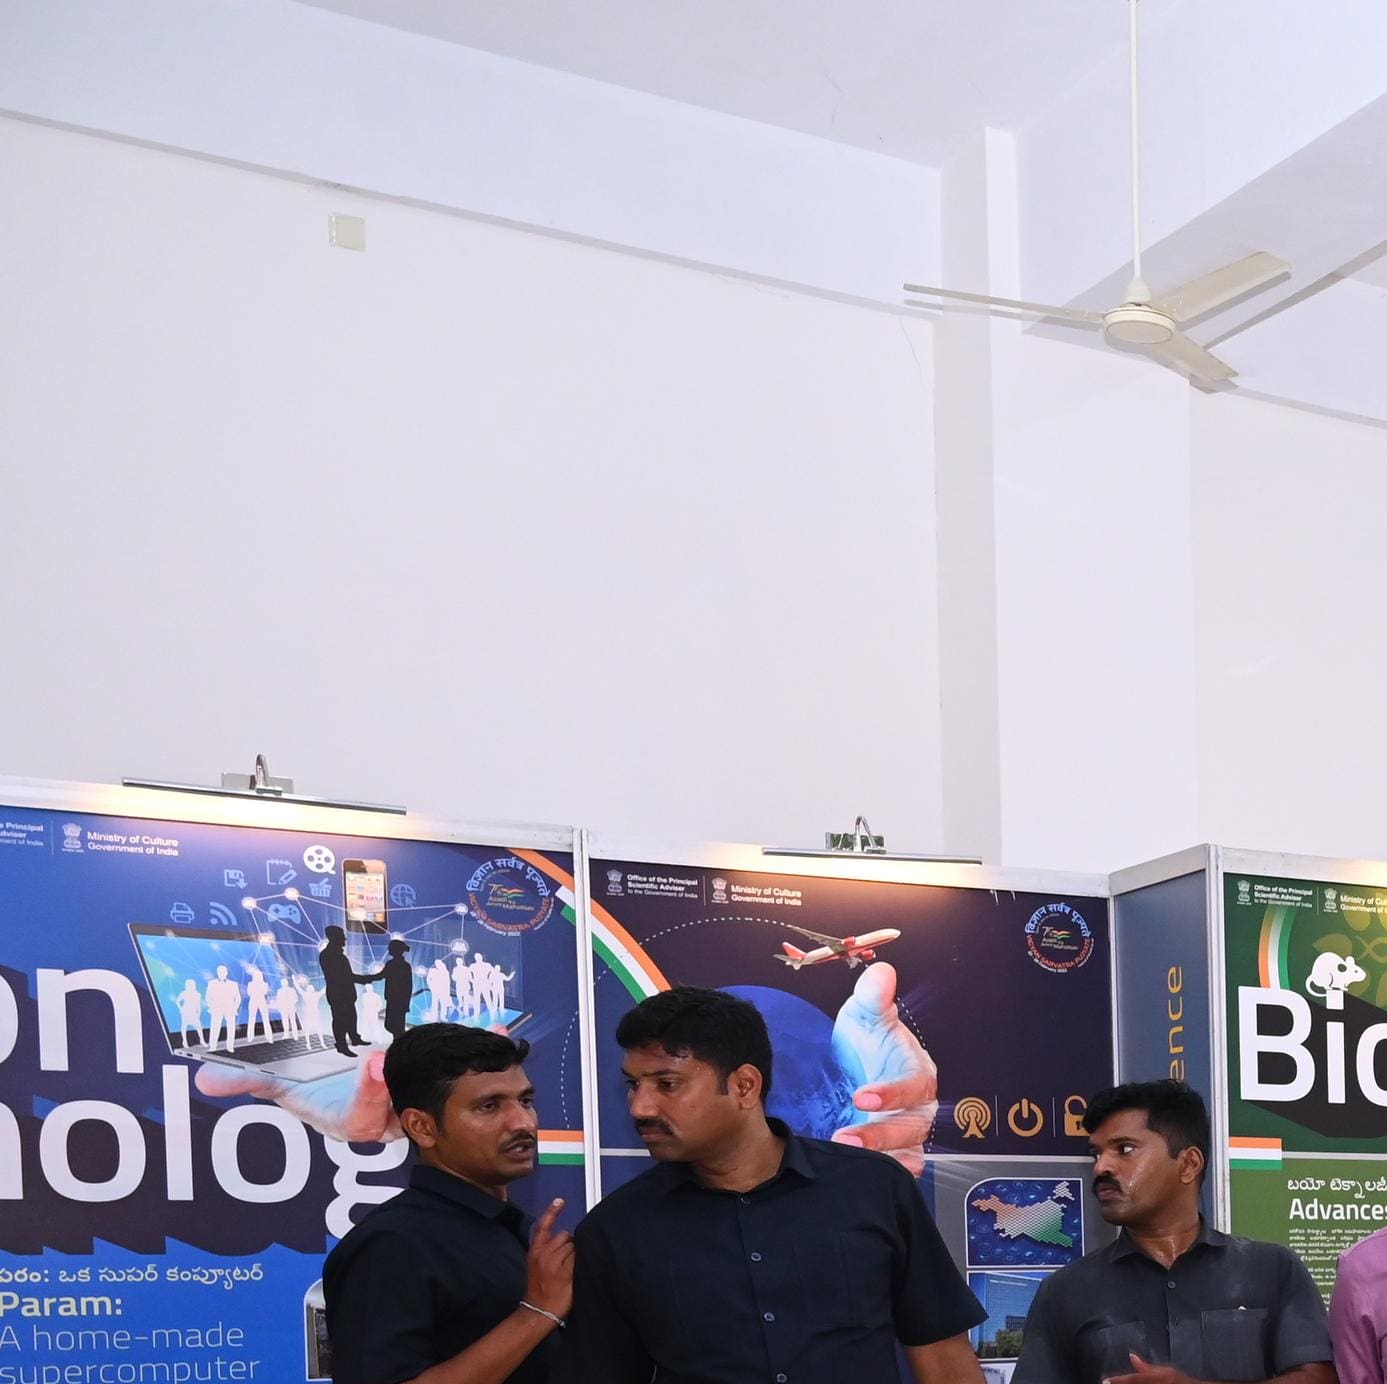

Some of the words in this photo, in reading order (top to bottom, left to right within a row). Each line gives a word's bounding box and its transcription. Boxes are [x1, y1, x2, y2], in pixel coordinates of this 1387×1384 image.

[5, 822, 44, 832] Principal
[0, 831, 27, 839] dviser
[87, 831, 128, 844] Ministry
[129, 834, 140, 843] of
[142, 835, 179, 847] Culture
[87, 841, 144, 854] Government
[145, 846, 156, 854] of
[156, 847, 179, 857] India
[627, 874, 648, 882] Office
[648, 875, 656, 883] of
[656, 876, 668, 884] the
[668, 877, 698, 887] Principal
[730, 884, 762, 898] Ministry
[764, 887, 772, 896] of
[772, 887, 802, 898] Culture
[731, 894, 775, 905] Government
[775, 896, 784, 905] of
[784, 897, 802, 907] India
[1340, 894, 1366, 905] Ministry
[1366, 896, 1374, 905] of
[1340, 903, 1376, 913] Government
[1376, 905, 1384, 913] of
[1287, 1178, 1326, 1192] బయో
[58, 1267, 91, 1283] ఒక
[99, 1263, 158, 1282] సుపర్
[0, 1291, 122, 1317] Param:
[0, 1325, 22, 1351] A
[32, 1321, 244, 1351] home-made
